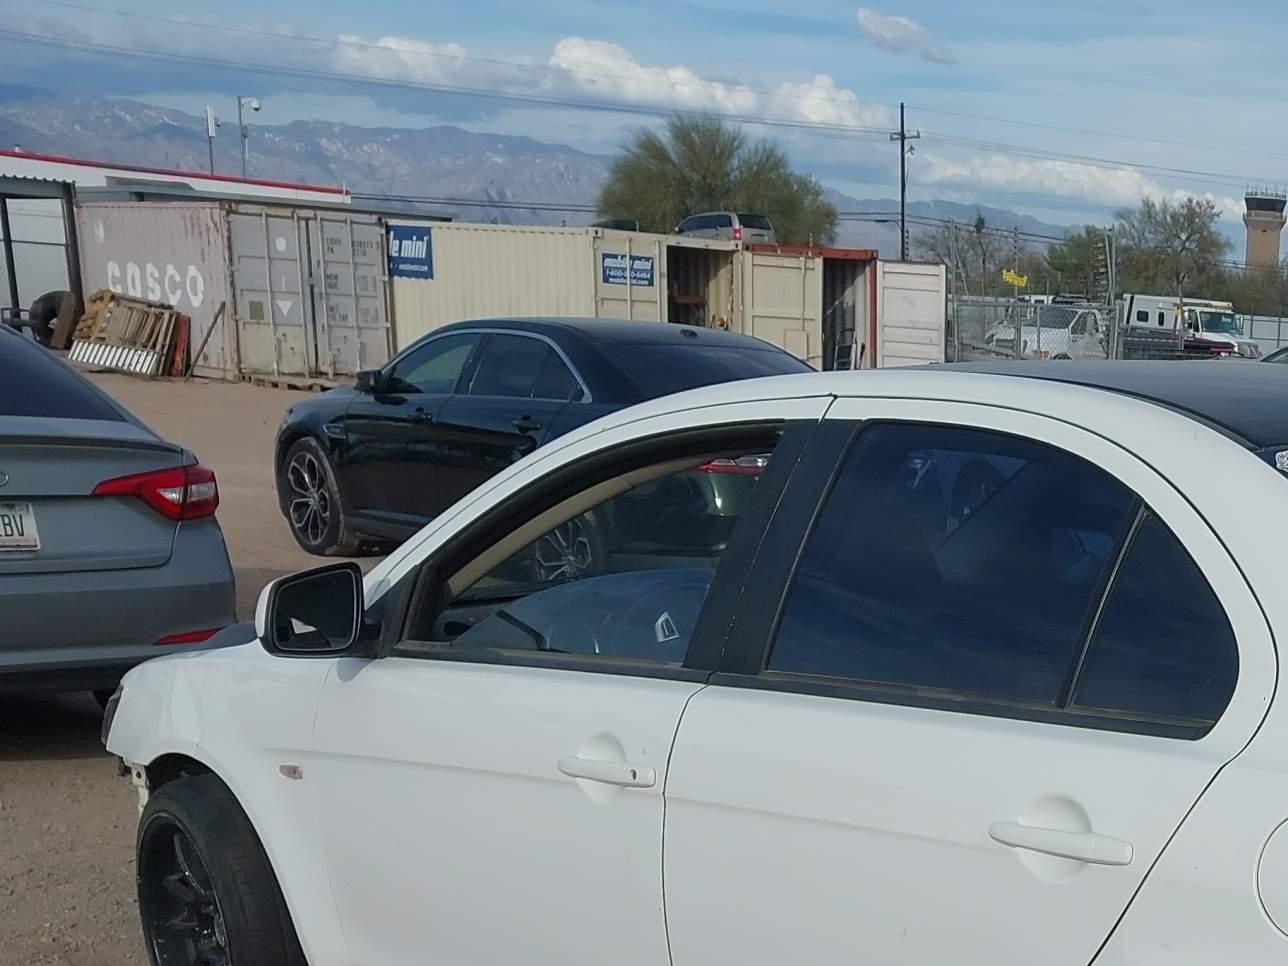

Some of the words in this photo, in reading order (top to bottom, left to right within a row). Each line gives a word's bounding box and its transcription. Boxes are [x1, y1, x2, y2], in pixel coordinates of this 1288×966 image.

[401, 235, 429, 259] mini
[633, 259, 652, 269] mini
[106, 260, 205, 308] COSCO
[0, 513, 25, 537] BV
